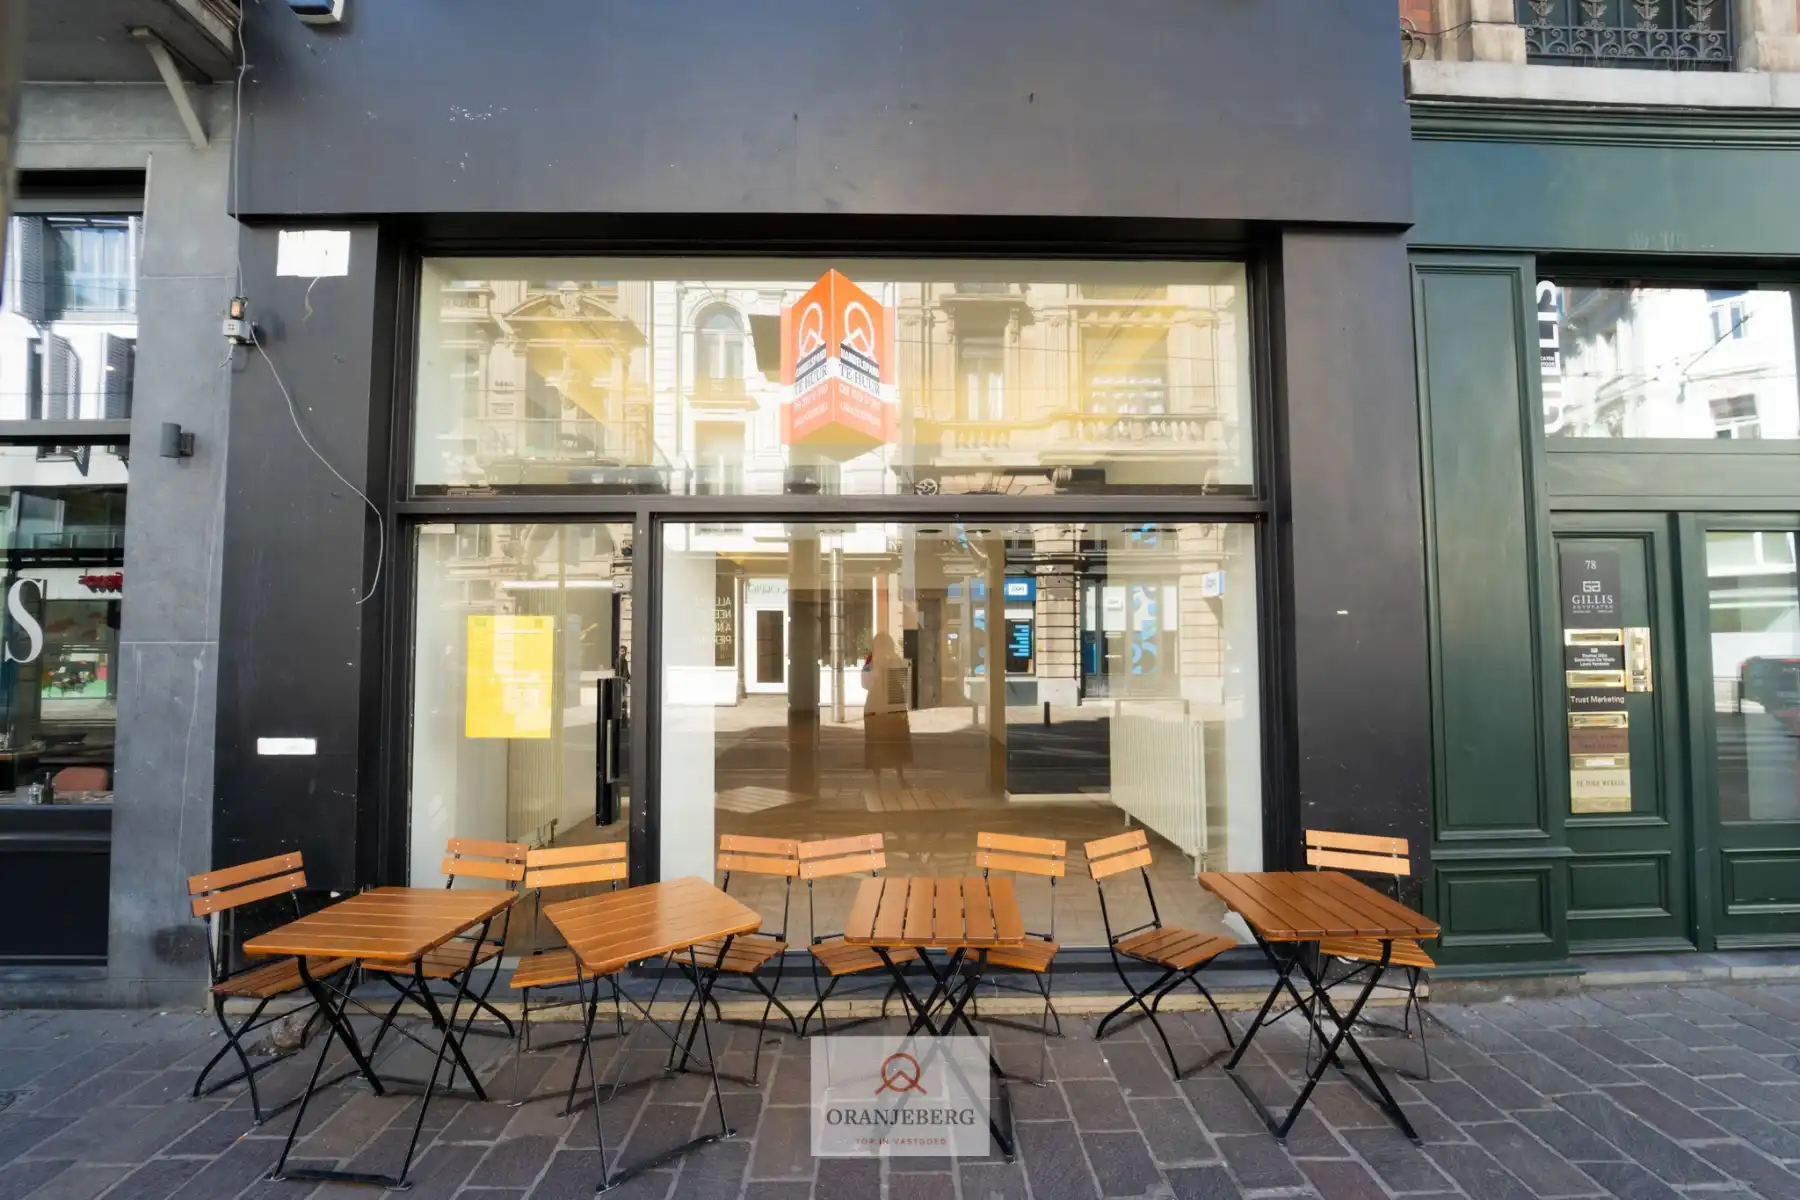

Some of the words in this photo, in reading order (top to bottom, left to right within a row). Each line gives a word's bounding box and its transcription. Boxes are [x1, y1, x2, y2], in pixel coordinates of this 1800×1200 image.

[839, 363, 853, 381] TE
[854, 371, 880, 396] HUUR
[1585, 560, 1597, 570] 78
[1572, 595, 1613, 604] GILLIS
[4, 578, 44, 664] S
[1590, 696, 1625, 704] Marketing
